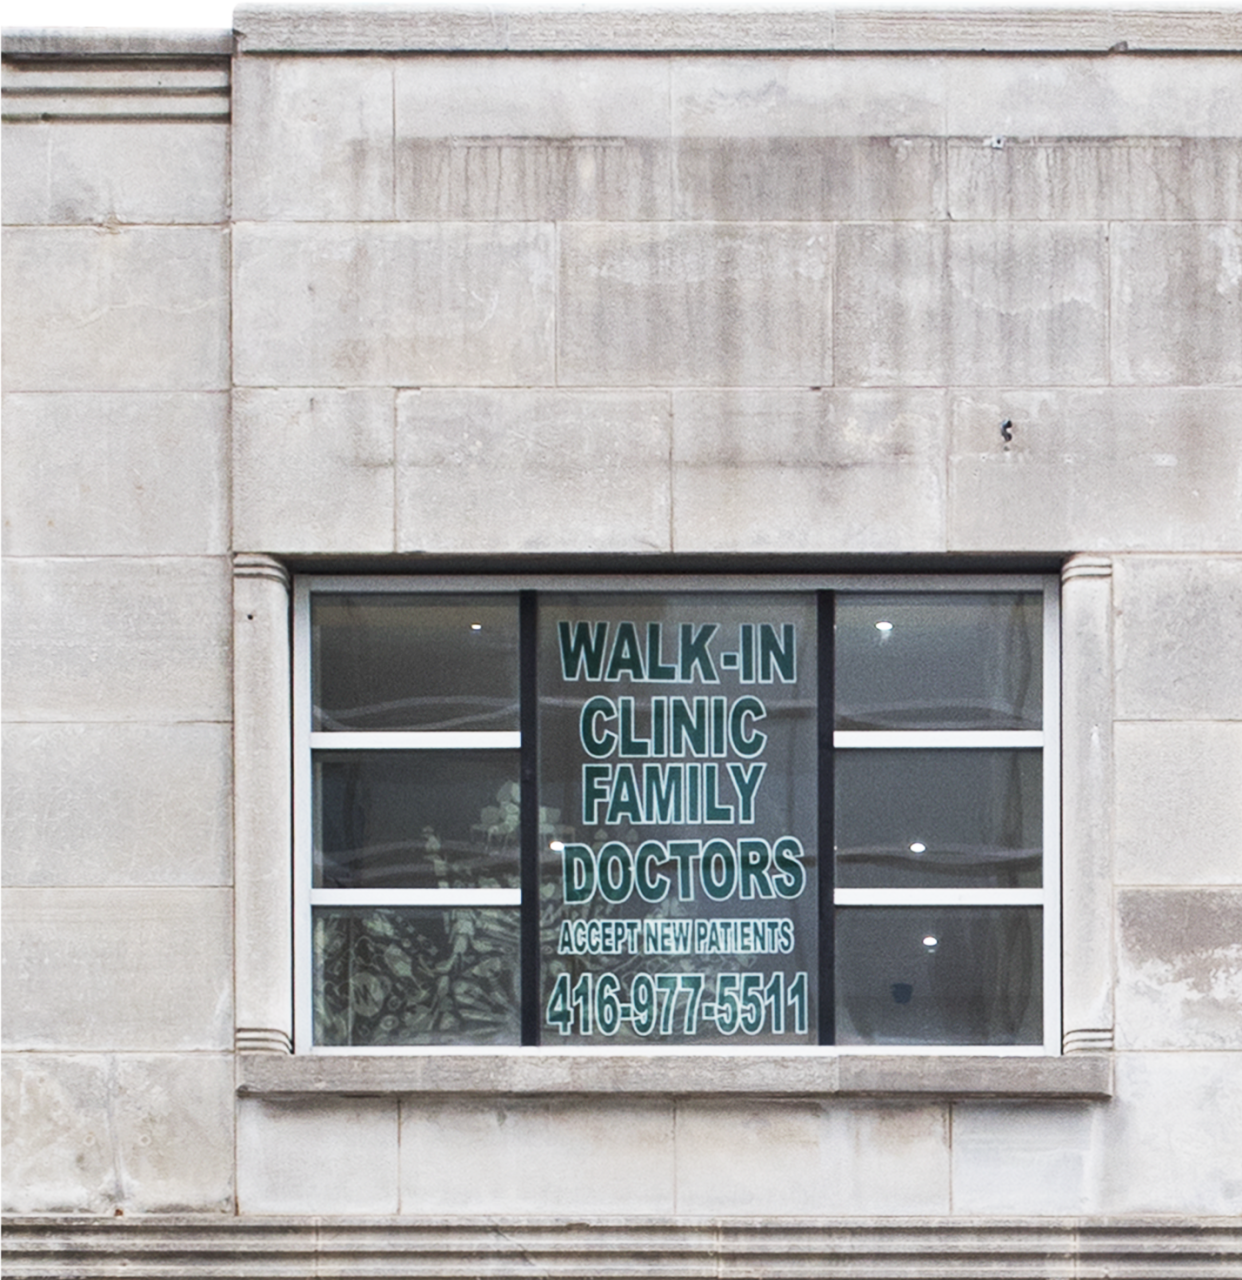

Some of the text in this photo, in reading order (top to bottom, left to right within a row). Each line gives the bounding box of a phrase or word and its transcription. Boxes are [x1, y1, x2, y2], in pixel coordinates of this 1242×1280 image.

[558, 621, 797, 683] WALK-IN
[580, 695, 767, 758] CLINIC
[582, 763, 767, 825] FAMILY
[562, 836, 806, 903] DOCTORS
[558, 918, 794, 954] ACCEPT NEW PATIENTS
[546, 972, 808, 1035] 416-977-5511
